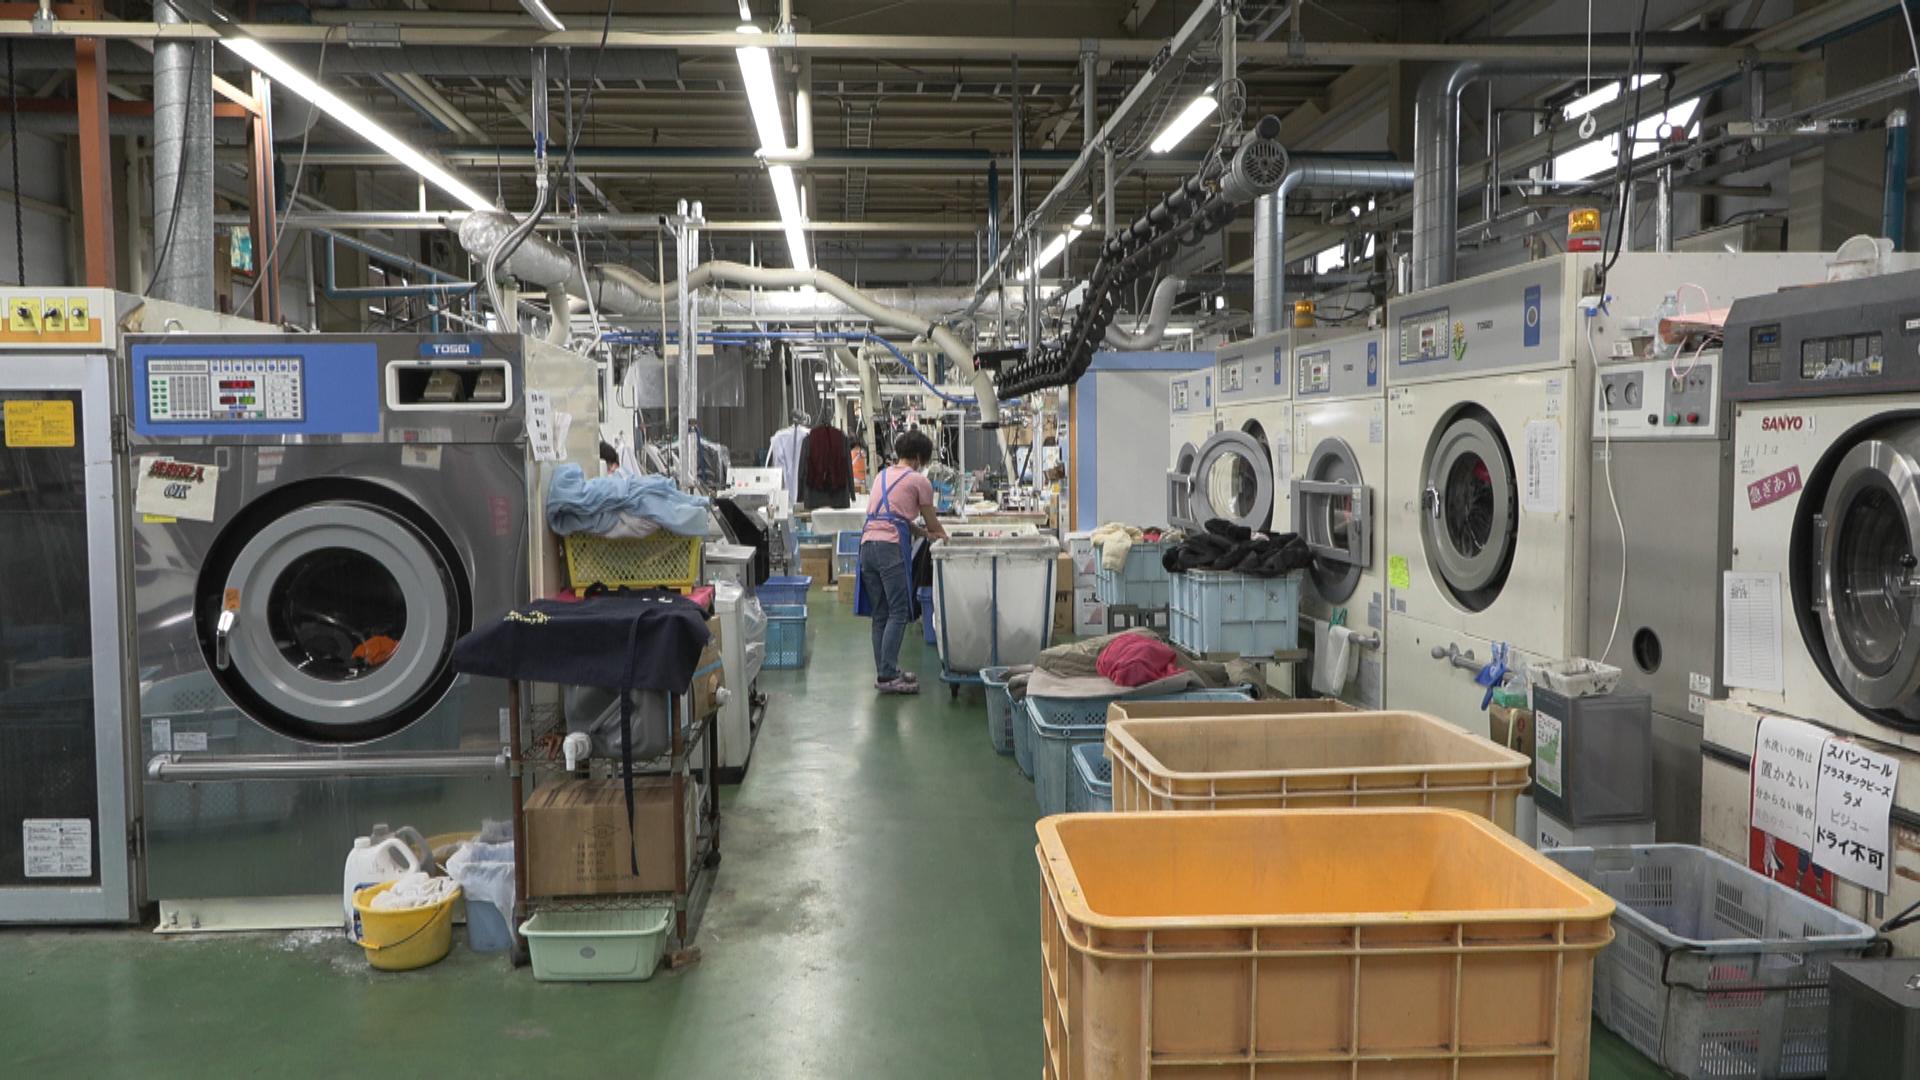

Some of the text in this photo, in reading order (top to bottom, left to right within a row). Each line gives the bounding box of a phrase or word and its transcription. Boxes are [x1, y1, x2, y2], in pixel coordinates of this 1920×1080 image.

[433, 344, 470, 355] TOSEI
[1762, 416, 1802, 431] SANYO
[164, 483, 192, 499] OK
[1749, 471, 1797, 503] 急ぎあり
[1764, 738, 1813, 763] 水洗いの物は
[1827, 744, 1893, 777] スパンコール
[1761, 760, 1810, 790] 置かない
[1823, 764, 1892, 798] プラスチックビーズ
[1842, 791, 1864, 808] ラメ
[1816, 825, 1885, 871] ドライ不可
